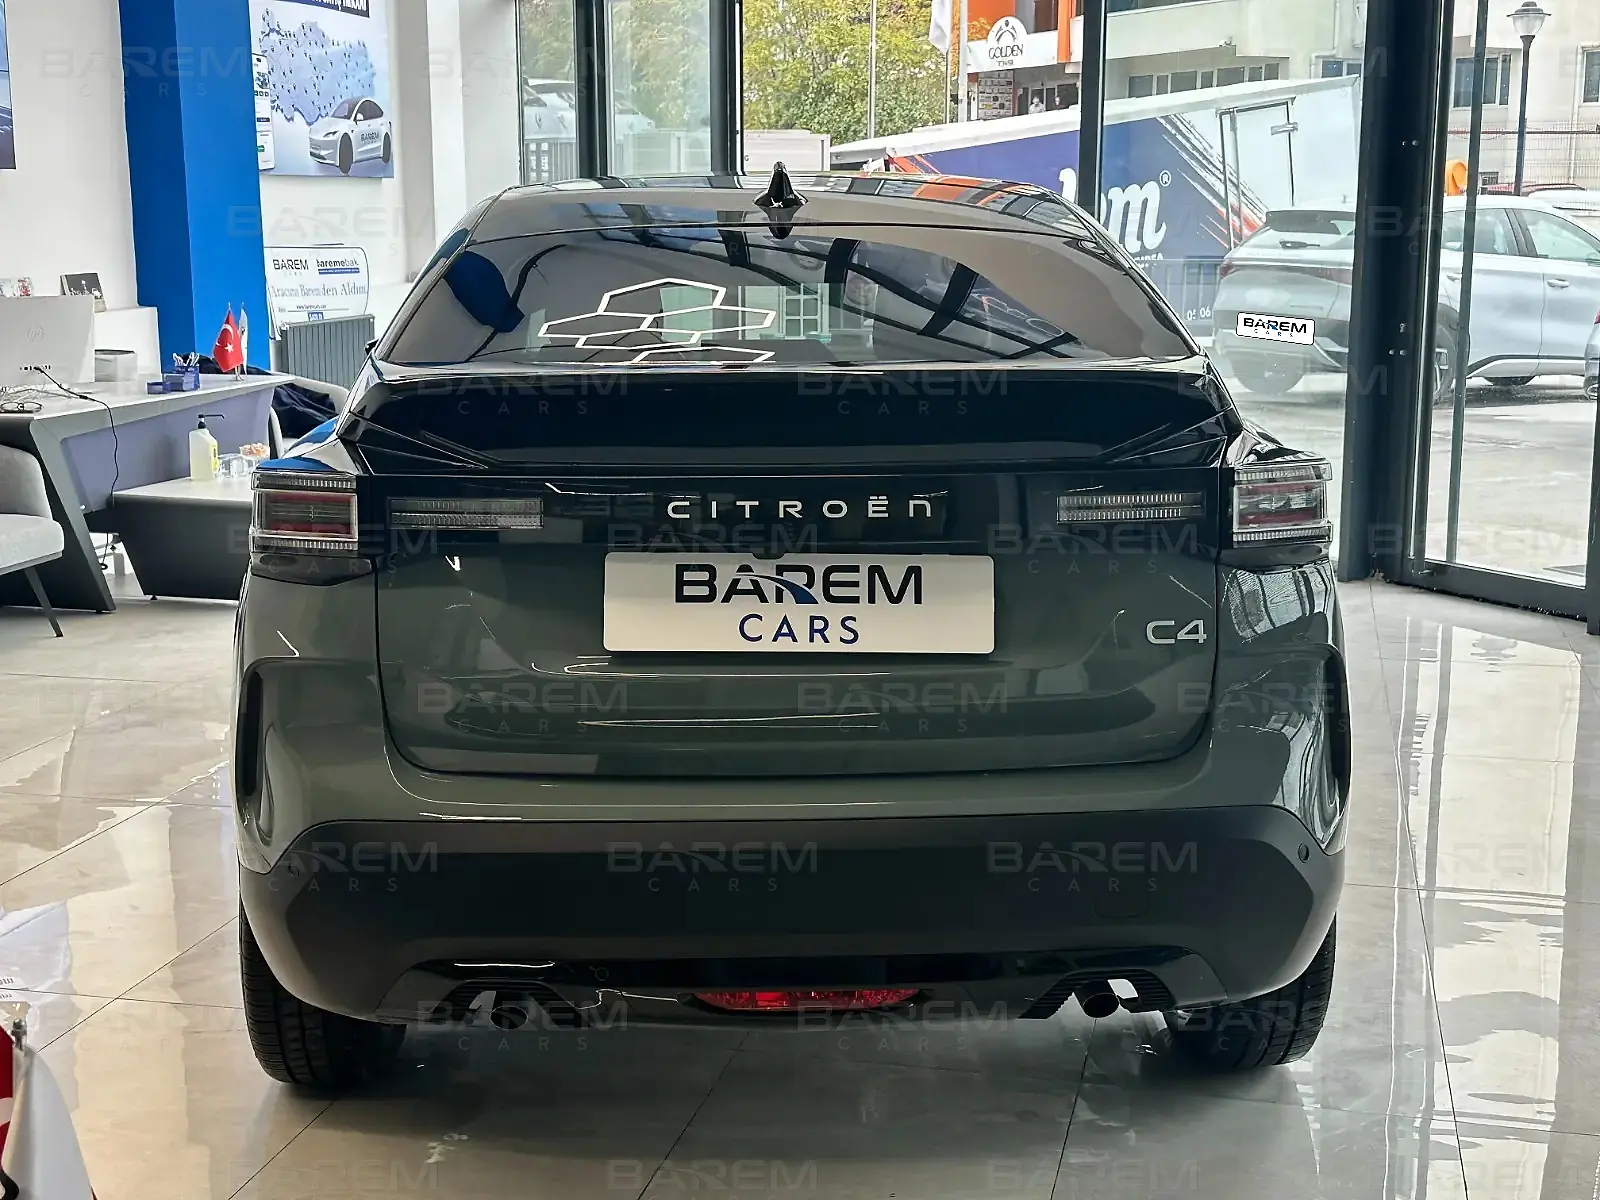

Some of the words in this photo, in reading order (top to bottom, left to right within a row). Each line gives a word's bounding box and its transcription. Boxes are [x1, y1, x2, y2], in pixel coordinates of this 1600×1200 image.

[988, 44, 1024, 60] GOLDEN
[272, 258, 309, 271] BAREM
[1199, 306, 1212, 318] 06
[675, 563, 924, 605] BAREM
[738, 613, 860, 644] CARS
[1146, 619, 1207, 644] C4
